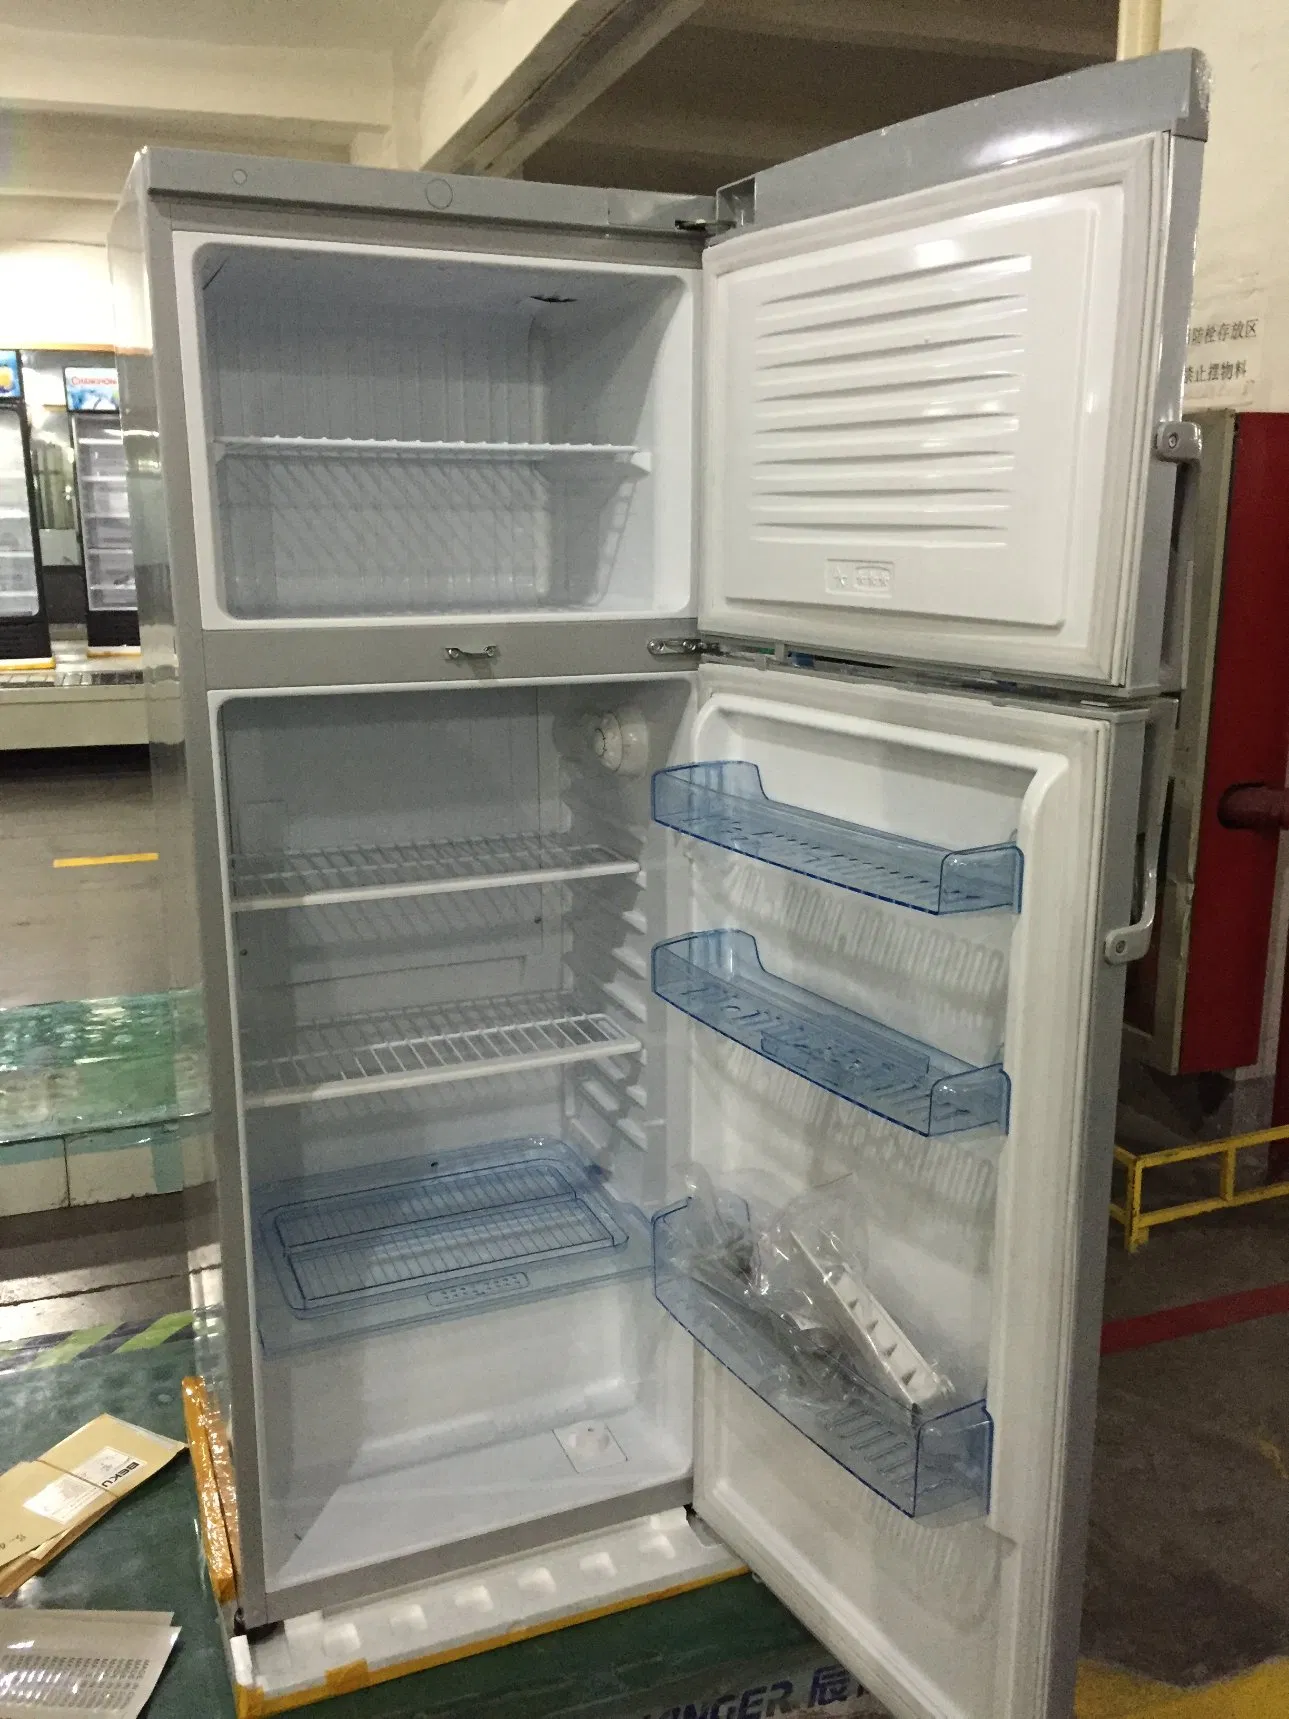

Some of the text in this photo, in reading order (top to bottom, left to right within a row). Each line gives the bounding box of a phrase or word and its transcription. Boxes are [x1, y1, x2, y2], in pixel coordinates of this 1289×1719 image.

[1188, 319, 1258, 344] 防栓存放区
